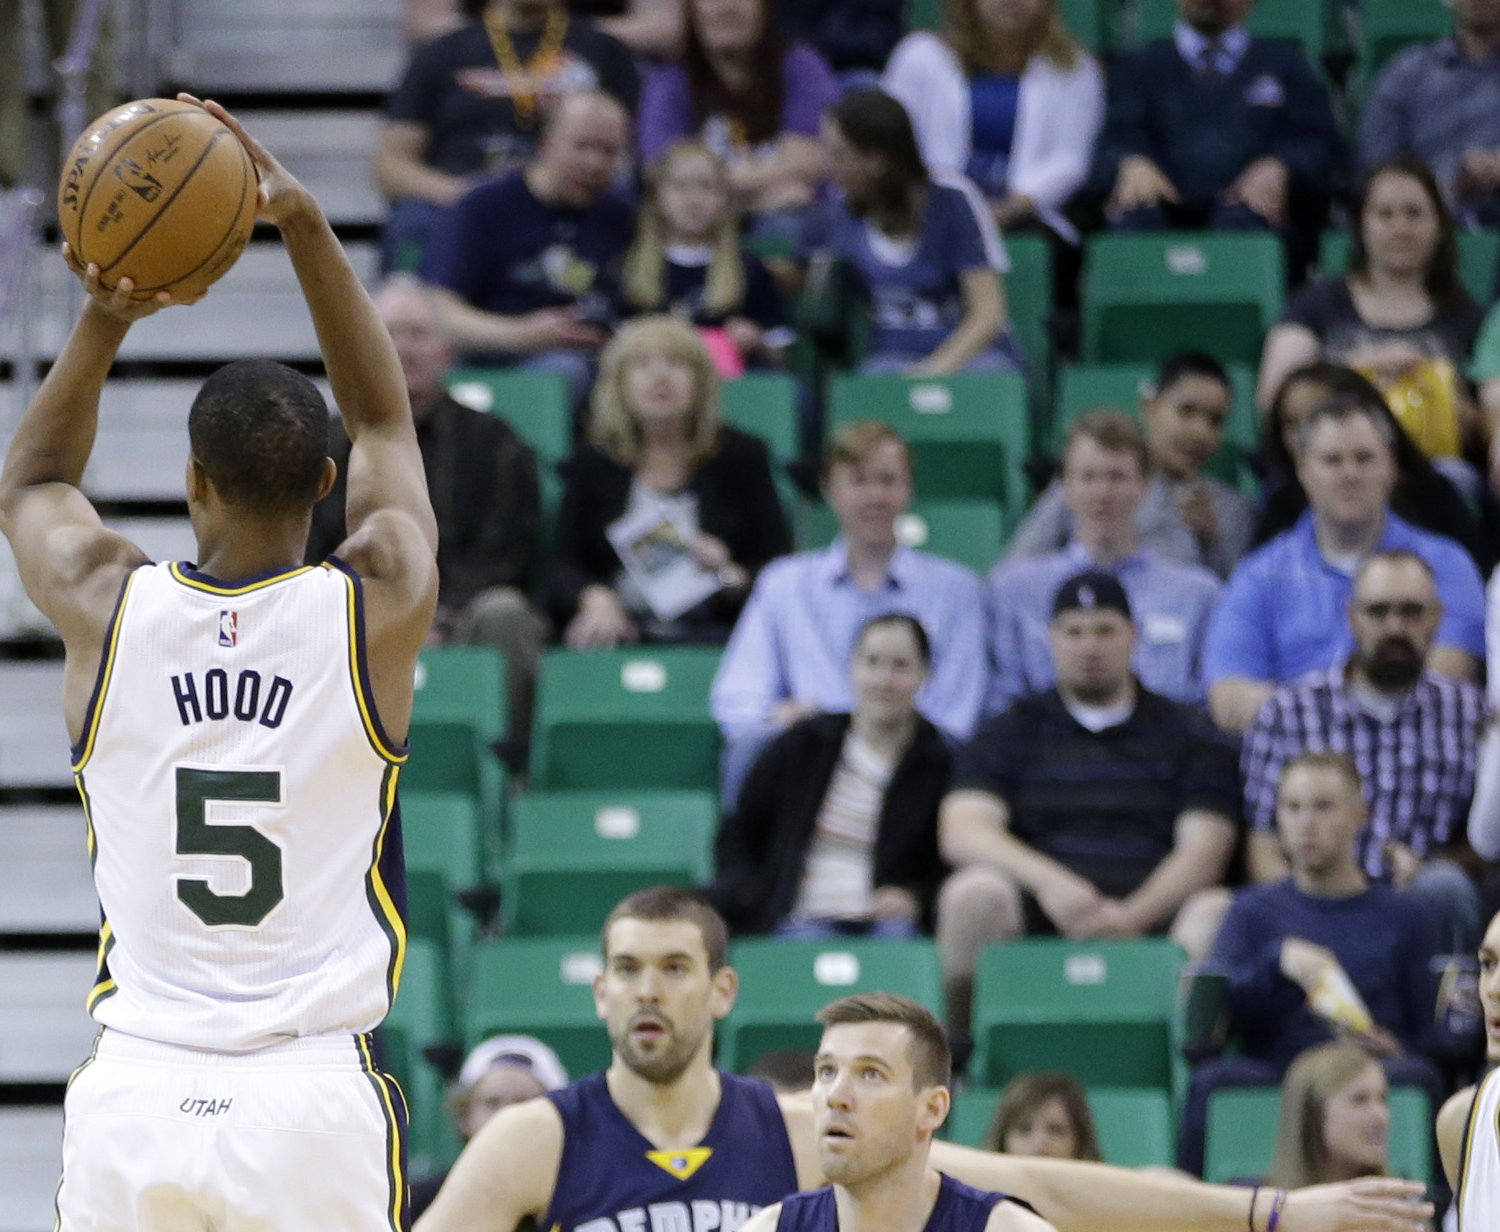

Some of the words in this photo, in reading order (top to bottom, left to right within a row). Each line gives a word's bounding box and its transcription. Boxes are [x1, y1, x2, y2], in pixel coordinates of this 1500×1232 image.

[170, 668, 293, 729] HOOD
[174, 766, 286, 927] 5
[180, 1098, 232, 1117] UTAH
